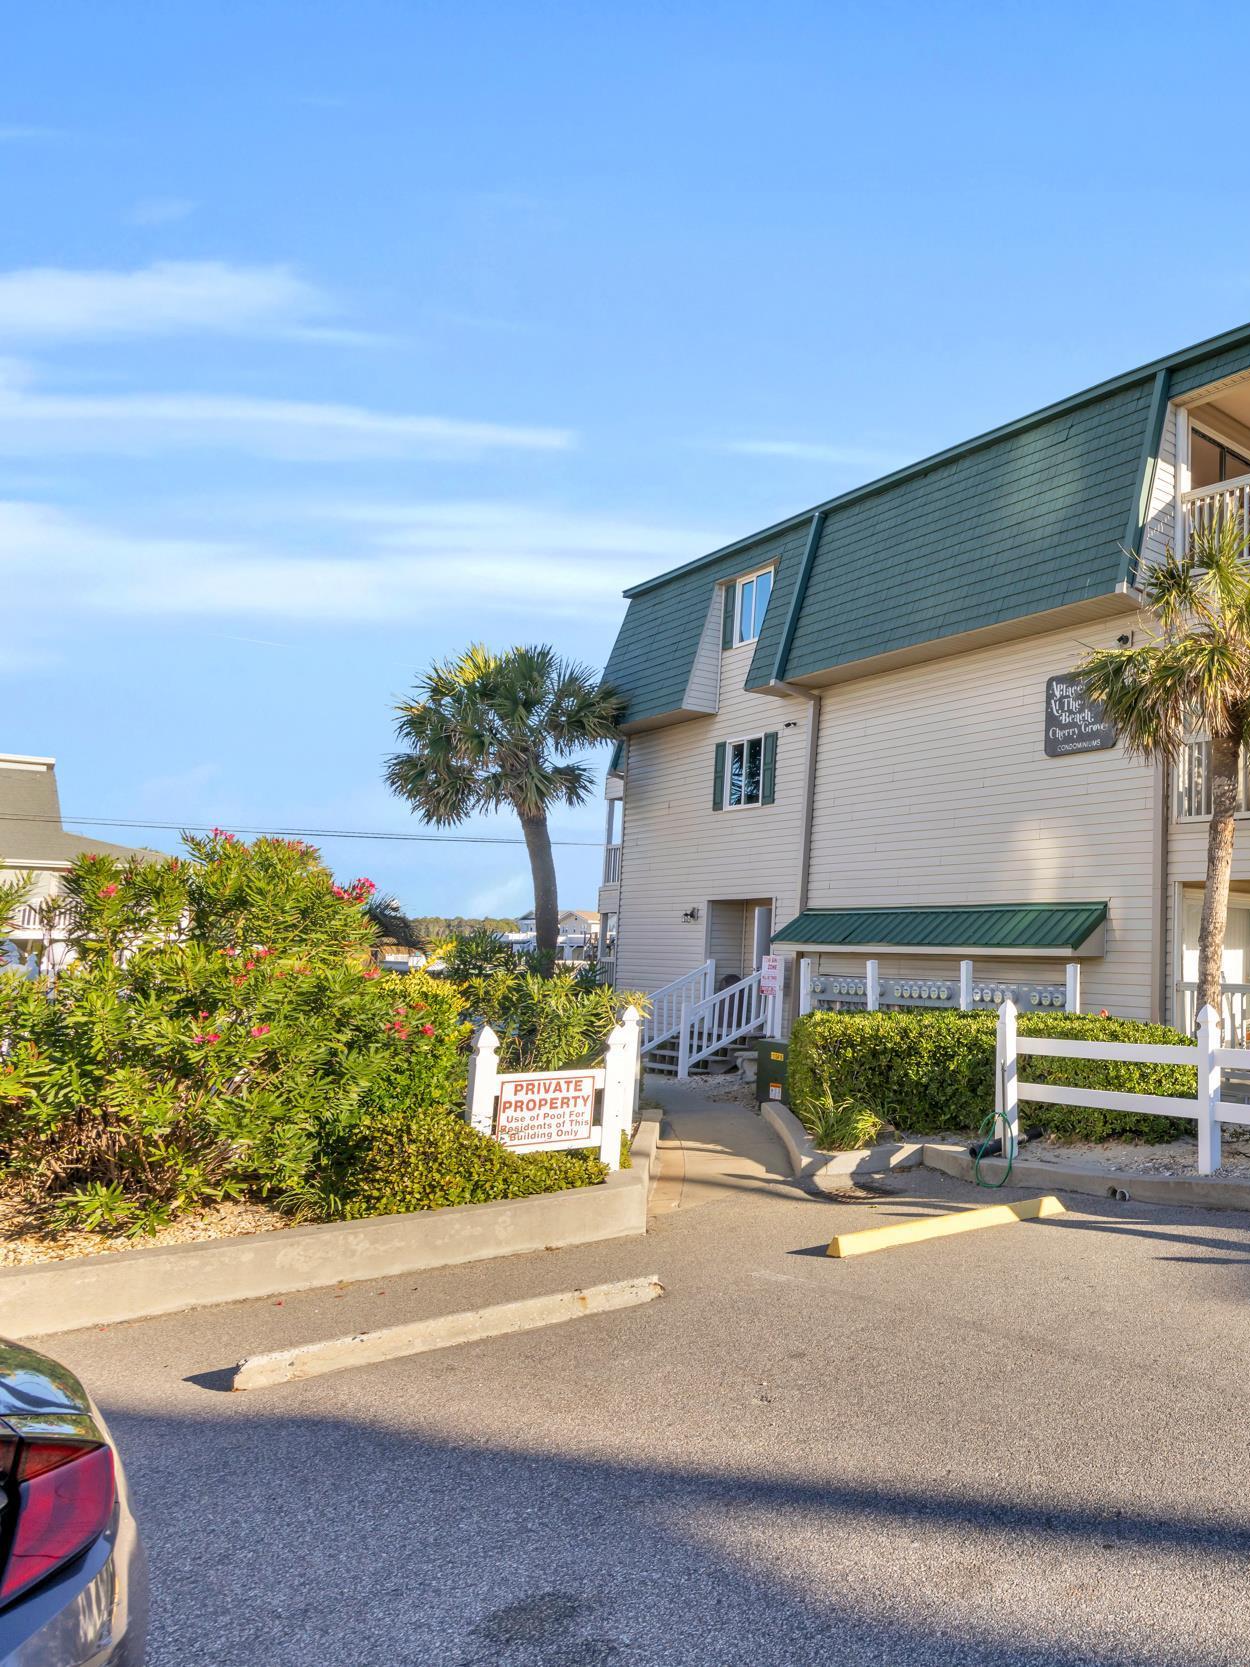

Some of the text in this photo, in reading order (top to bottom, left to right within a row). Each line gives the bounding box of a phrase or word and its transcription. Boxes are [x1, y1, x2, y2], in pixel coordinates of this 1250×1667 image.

[1063, 698, 1082, 712] The
[1049, 721, 1108, 740] Cherry Grove
[1057, 739, 1101, 752] CONDOMINIUMS
[514, 1080, 583, 1096] PRIVATE
[502, 1095, 591, 1113] PROPERTY
[506, 1110, 585, 1123] Use of Pool For
[500, 1121, 552, 1134] Residents
[556, 1120, 565, 1128] of
[509, 1128, 578, 1141] Building Only
